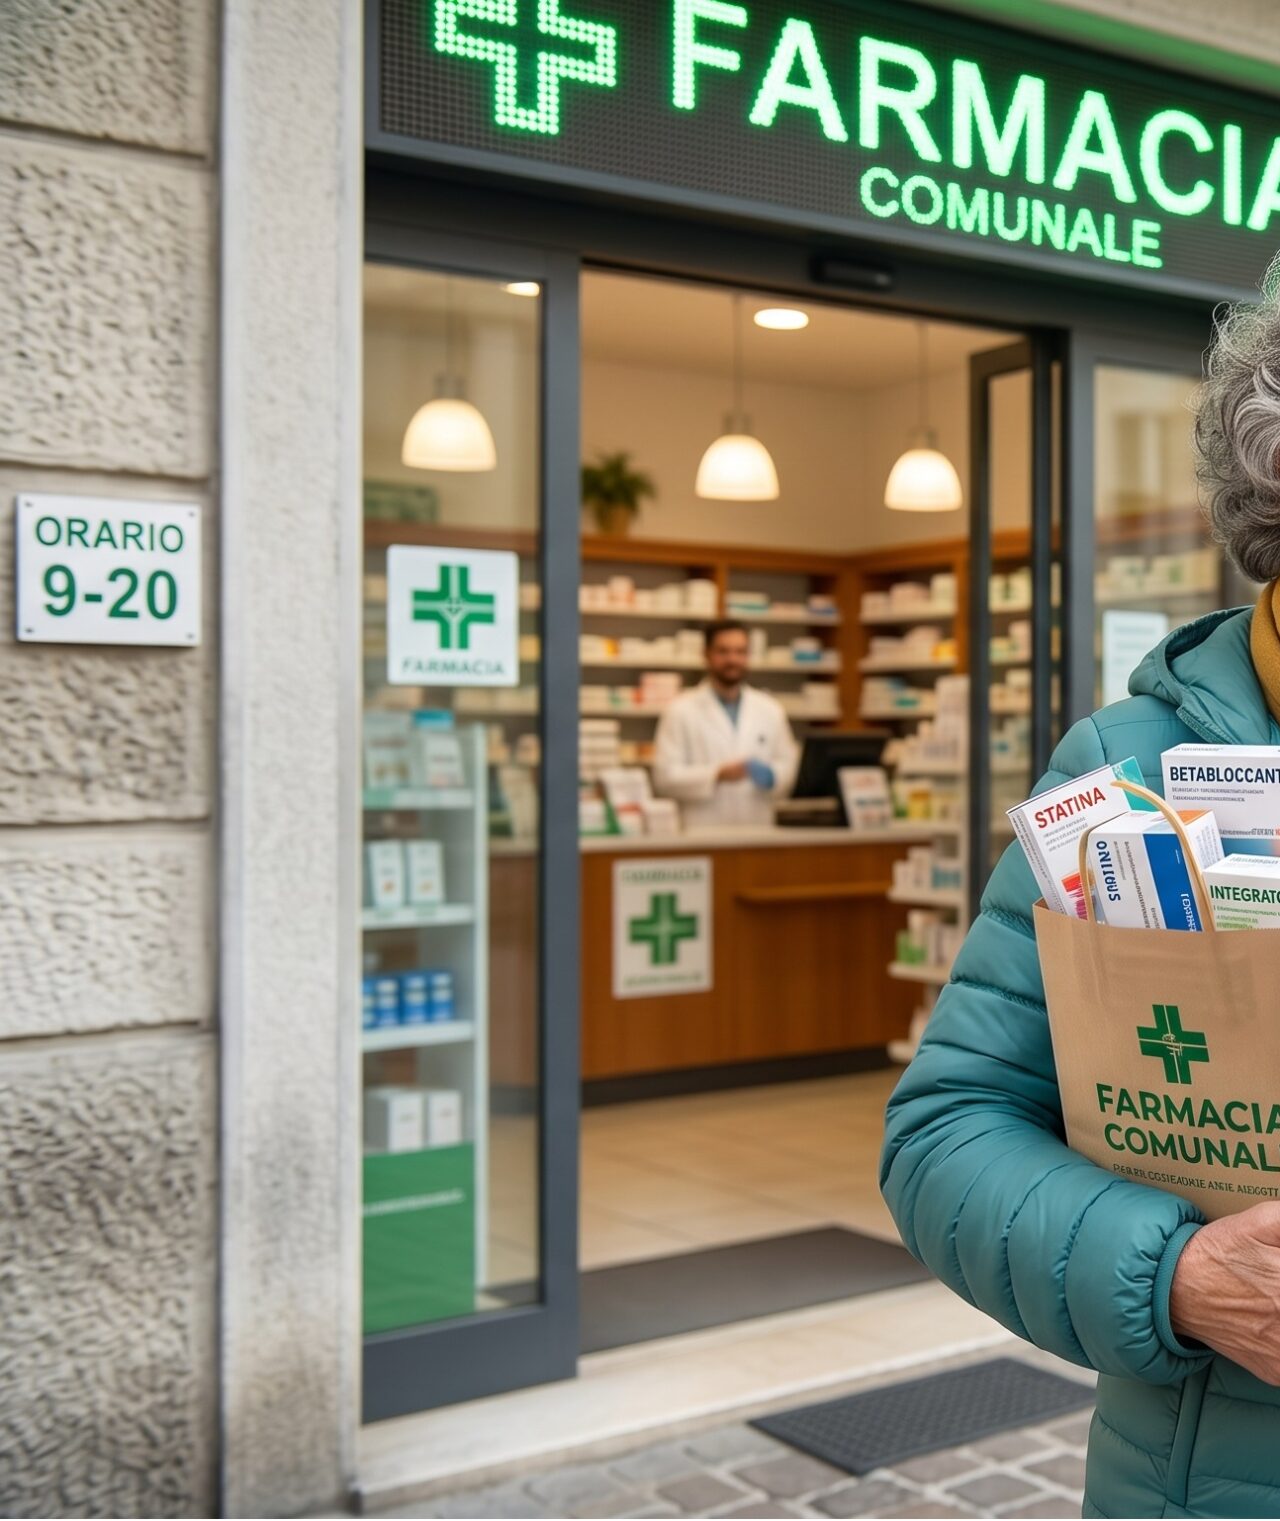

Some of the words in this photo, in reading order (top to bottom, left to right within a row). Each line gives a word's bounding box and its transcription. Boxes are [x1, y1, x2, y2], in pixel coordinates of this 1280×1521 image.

[860, 166, 1164, 269] COMUNALE
[35, 516, 184, 553] ORARIO
[43, 564, 178, 620] 9-20
[1034, 786, 1106, 829] STATINA
